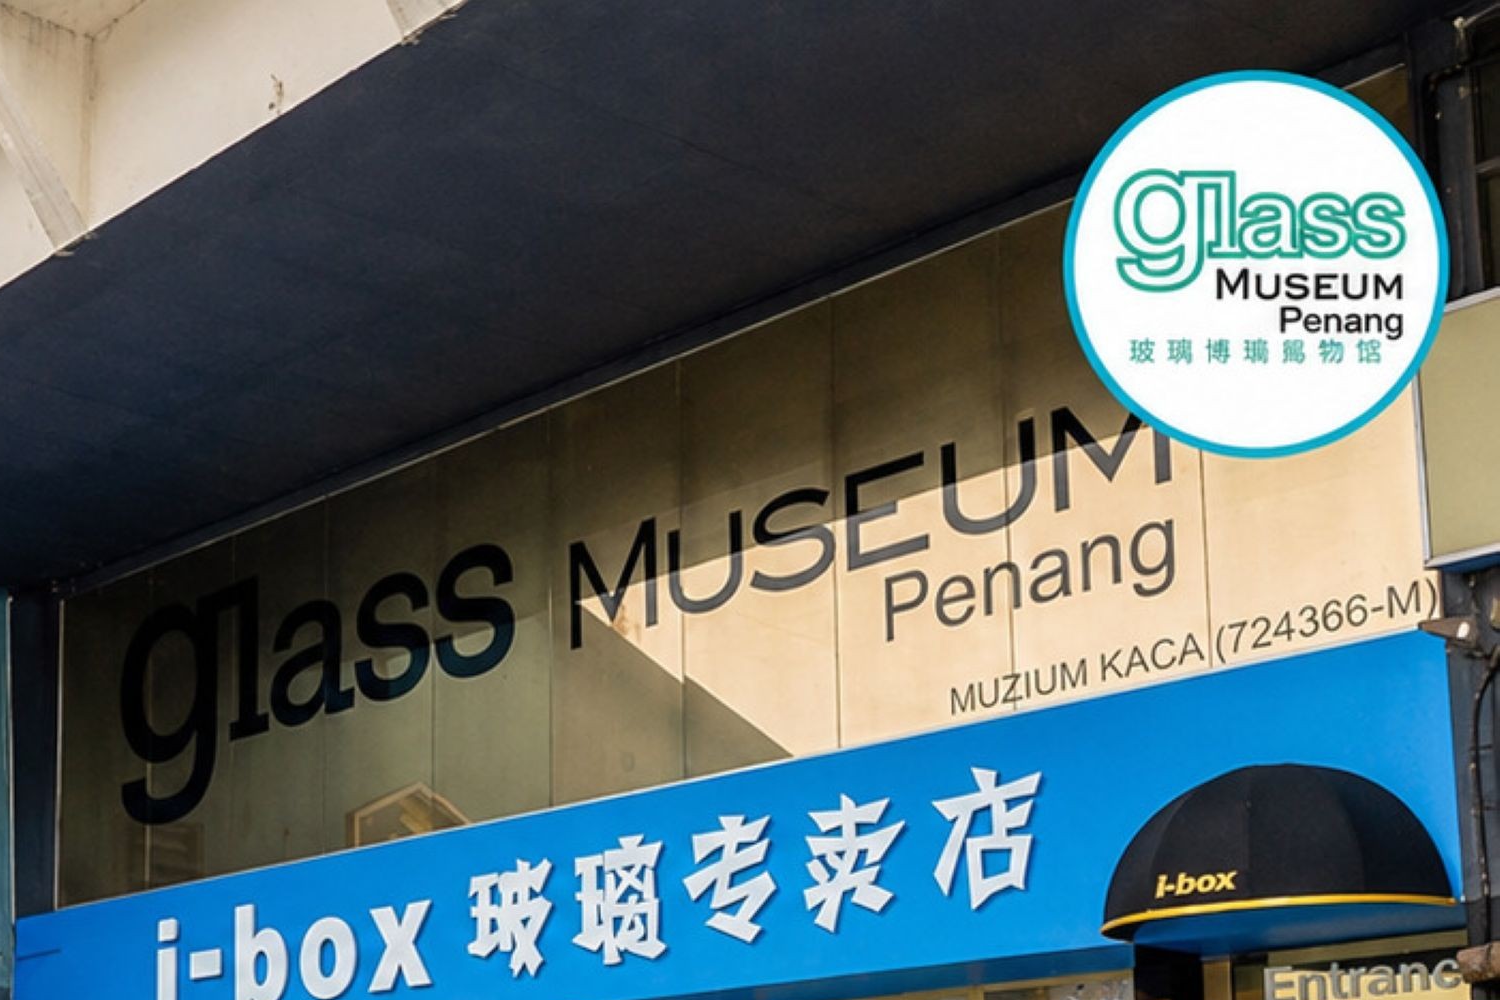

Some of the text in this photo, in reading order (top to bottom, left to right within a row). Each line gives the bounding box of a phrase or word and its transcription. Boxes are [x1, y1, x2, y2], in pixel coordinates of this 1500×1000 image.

[119, 405, 1173, 826] glass MUSEUM
[884, 518, 1176, 643] Penang
[950, 575, 1439, 716] MUZIUM KACA (724366-M)
[467, 767, 1042, 980] 玻璃专卖店
